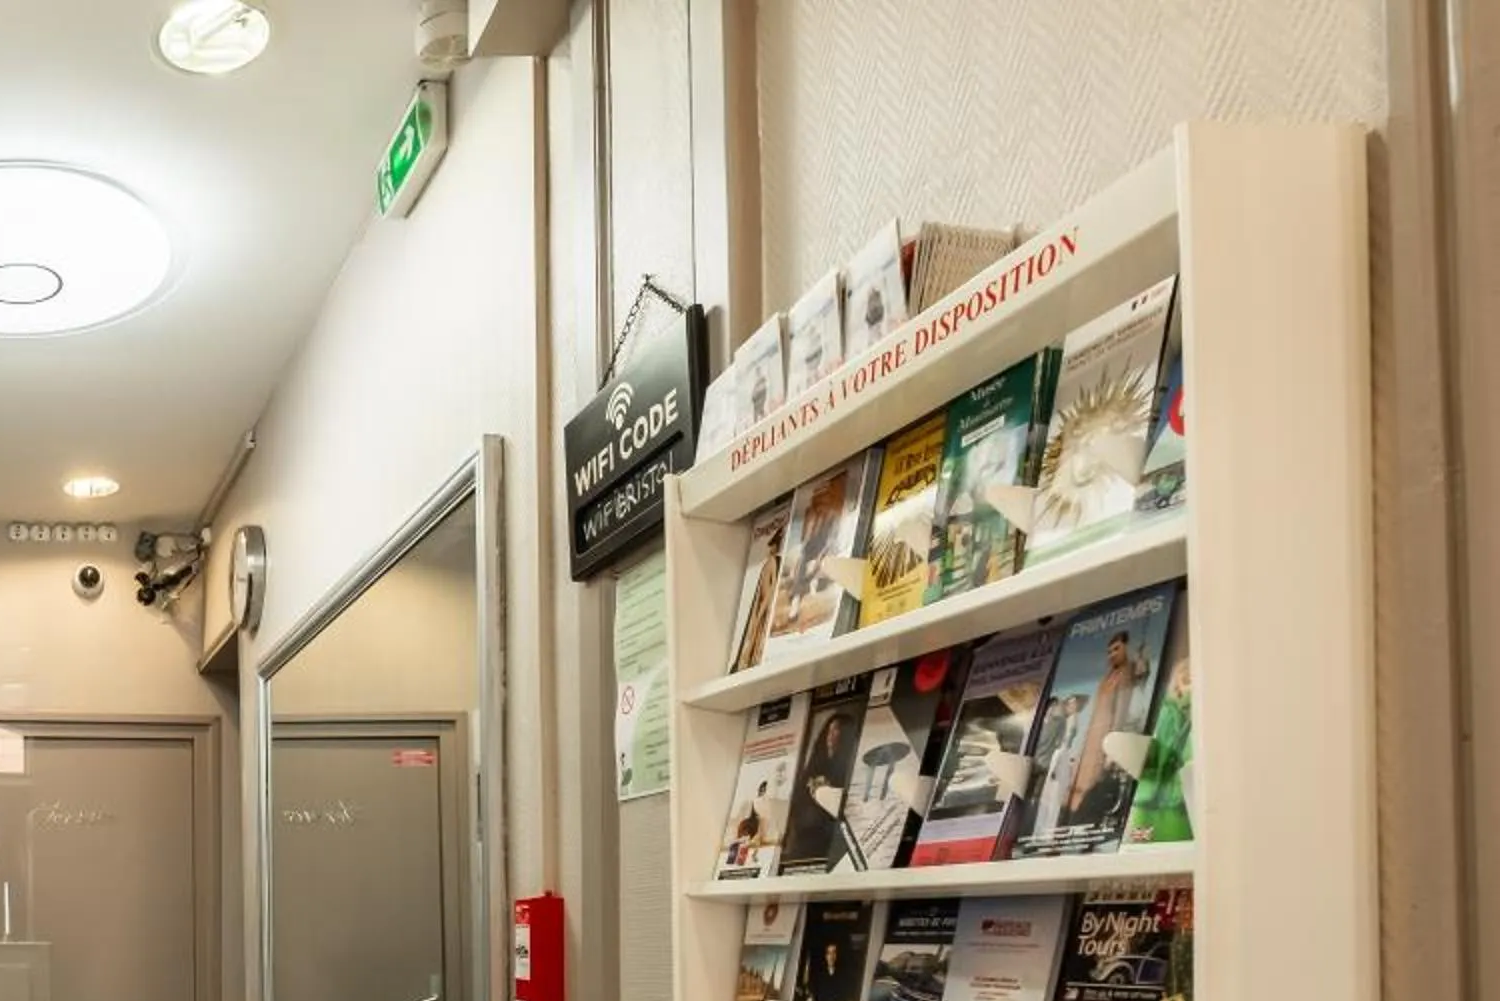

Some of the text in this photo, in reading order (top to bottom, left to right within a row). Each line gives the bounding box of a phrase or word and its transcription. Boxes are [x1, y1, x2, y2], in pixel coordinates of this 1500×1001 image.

[730, 397, 820, 472] DÉPLIANTS
[825, 380, 837, 411] À
[840, 339, 908, 403] VOTRE
[913, 226, 1080, 357] DISPOSITION
[574, 387, 680, 497] WIFI CODE
[1069, 594, 1165, 638] PRINTEMPS
[1081, 909, 1161, 938] By Night
[1077, 935, 1127, 957] Tours
